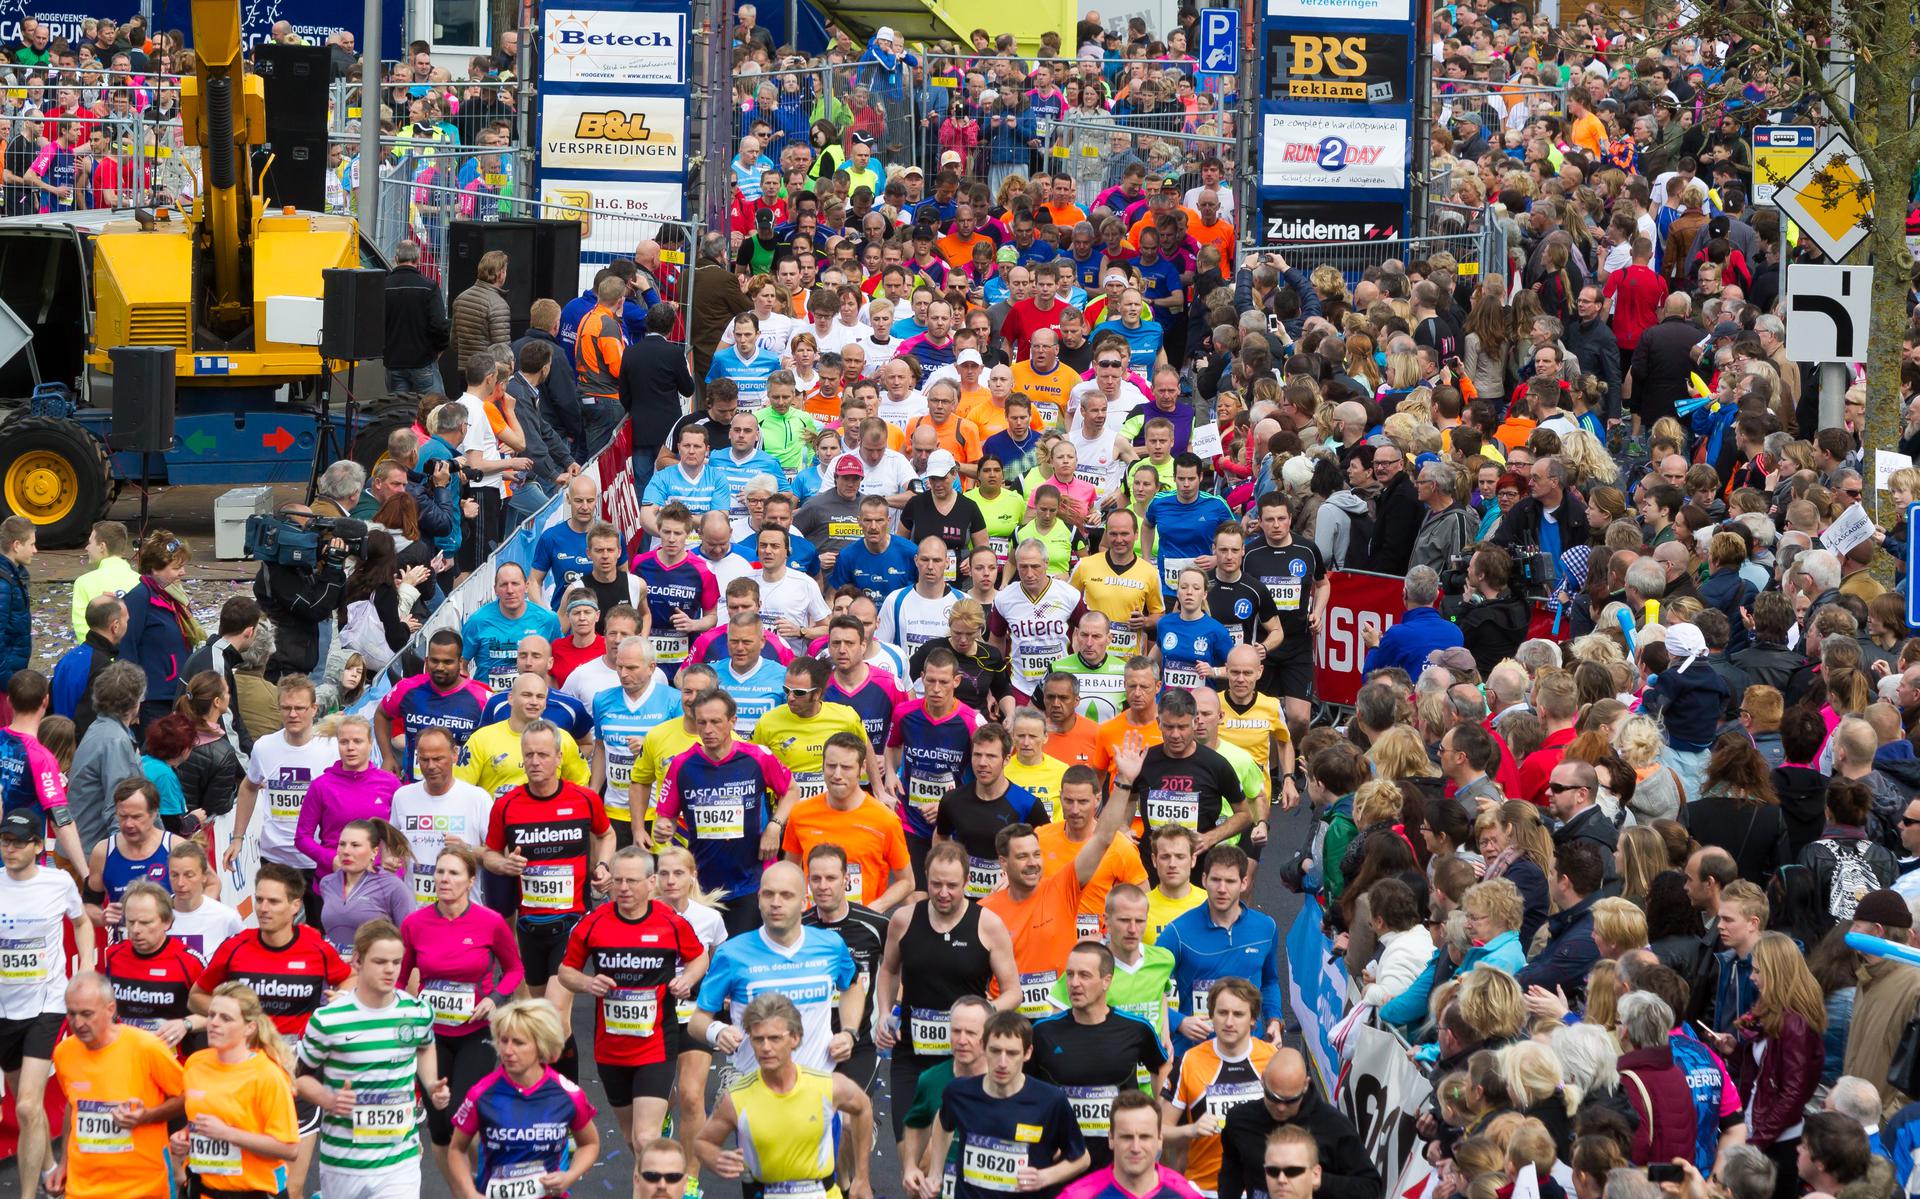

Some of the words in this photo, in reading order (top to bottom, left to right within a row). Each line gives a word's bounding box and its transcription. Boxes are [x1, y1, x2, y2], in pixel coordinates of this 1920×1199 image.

[1209, 15, 1230, 46] P
[560, 30, 673, 47] Betech
[1290, 35, 1368, 77] BRS
[1292, 83, 1363, 97] reklame
[1369, 84, 1393, 99] .nl
[575, 110, 650, 141] B&L
[1273, 118, 1285, 127] De
[1287, 119, 1330, 131] complete
[1332, 120, 1398, 133] hardloopwinkel
[549, 142, 677, 157] VERSPREIDINGEN
[595, 199, 623, 209] H.G.
[627, 199, 649, 210] Bos
[1267, 218, 1360, 240] Zuidema
[1035, 385, 1062, 393] VENKO
[1289, 560, 1304, 576] fit
[1104, 576, 1146, 591] JUMBO
[1234, 598, 1250, 616] fit
[1011, 620, 1064, 638] attero
[656, 640, 679, 651] 8773
[1022, 657, 1027, 669] T
[491, 677, 496, 688] T
[1078, 678, 1126, 688] ERBALIF
[1165, 672, 1170, 683] T
[1172, 673, 1197, 686] 8377
[406, 713, 475, 730] CASCADERUN
[1226, 719, 1271, 729] JUMBO
[40, 771, 58, 799] 2014
[684, 784, 756, 800] CASCADERUN
[911, 781, 917, 791] T
[1160, 778, 1193, 793] 2012
[270, 793, 275, 806] T
[695, 810, 701, 824] T
[703, 810, 734, 824] 9642
[1148, 804, 1154, 817] T
[1157, 805, 1189, 819] 8556
[515, 827, 583, 844] Zuidema
[533, 846, 564, 855] GROEP
[415, 878, 421, 892] T
[969, 871, 998, 885] 8441
[523, 880, 529, 892] T
[532, 880, 563, 894] 9591
[3, 953, 38, 968] 9543
[598, 952, 664, 970] Zuidema
[112, 983, 175, 1004] Zuidema
[604, 1003, 611, 1017] T
[613, 1004, 649, 1019] 9594
[920, 1024, 947, 1040] 880
[77, 1117, 84, 1129] T
[354, 1111, 361, 1125] T
[486, 1127, 567, 1141] CASCADERUN
[965, 1150, 972, 1166] T
[976, 1153, 1016, 1174] 9620
[490, 1184, 498, 1198] T
[500, 1179, 537, 1199] 8728
